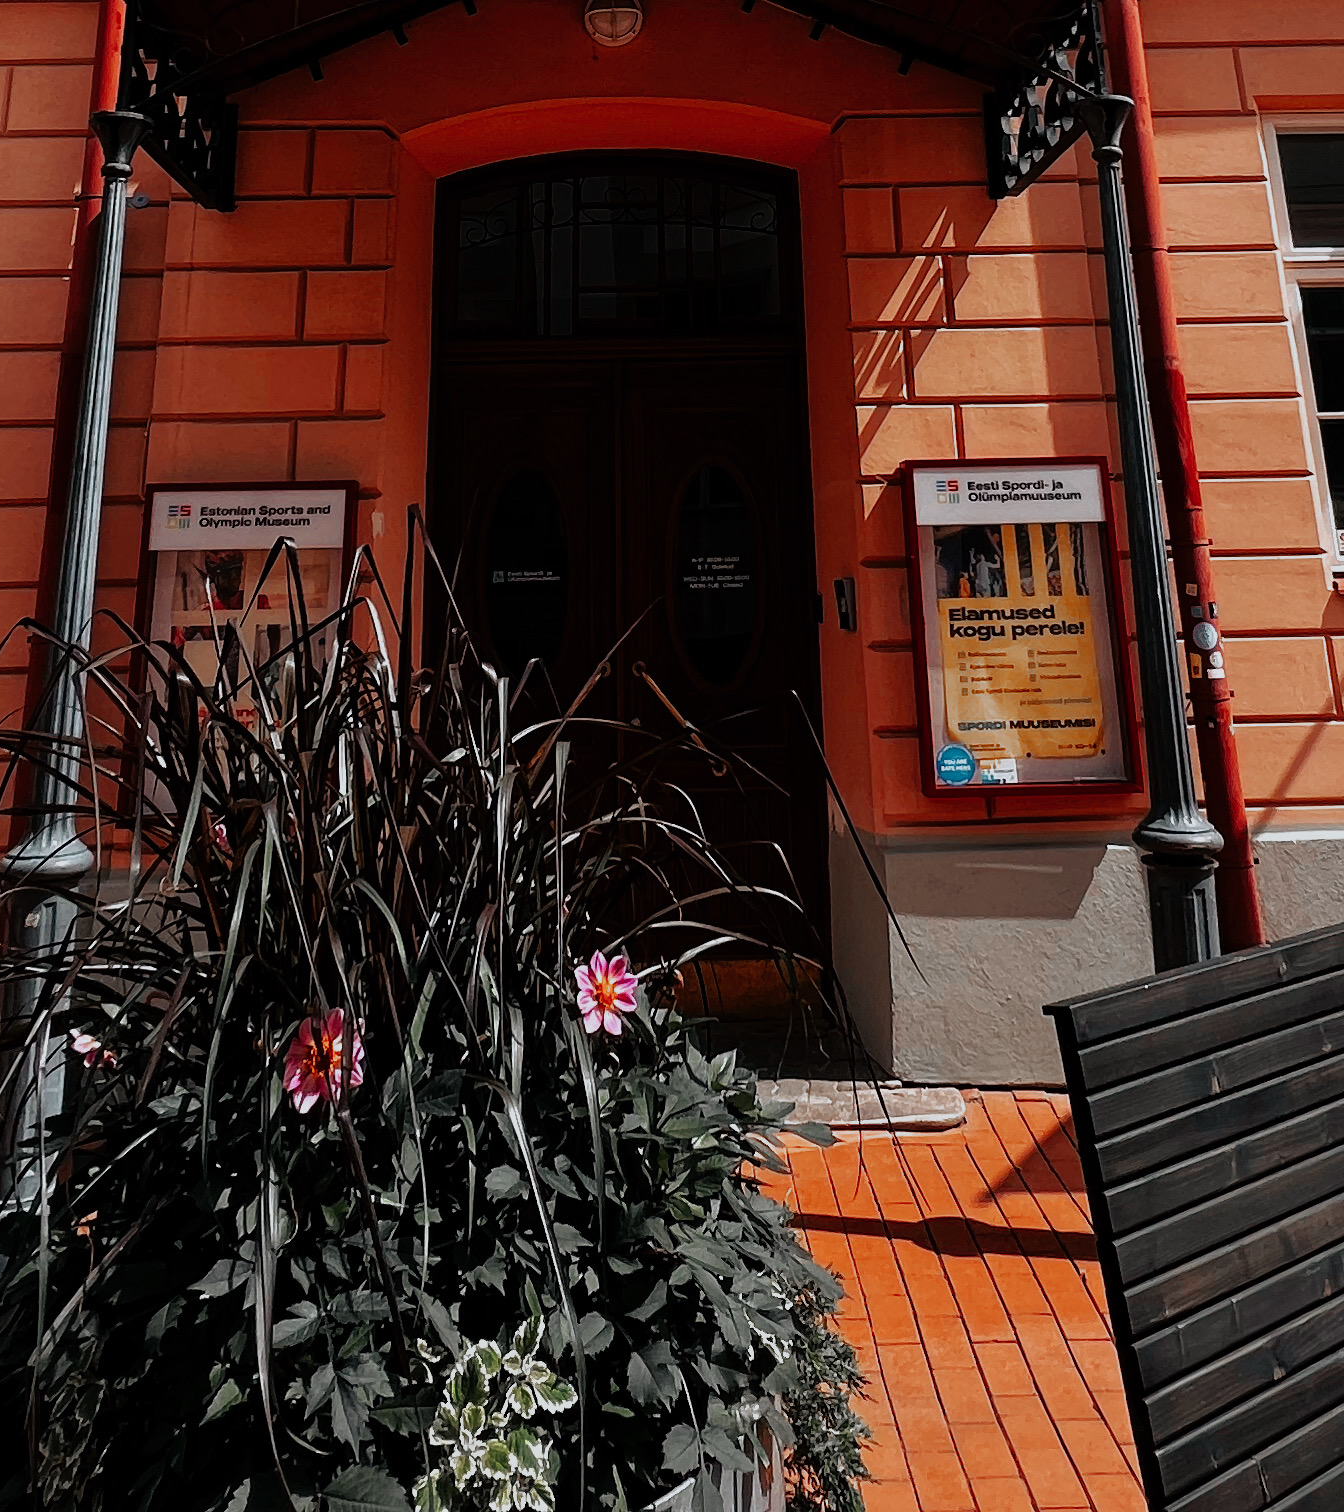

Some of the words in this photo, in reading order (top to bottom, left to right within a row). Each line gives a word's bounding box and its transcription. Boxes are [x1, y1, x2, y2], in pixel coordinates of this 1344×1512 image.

[967, 481, 999, 491] Eesti
[1002, 480, 1050, 492] Spordi-
[1052, 480, 1064, 491] ja
[968, 491, 1082, 503] Olümpiamuuseum
[200, 506, 256, 516] Estonian
[258, 505, 304, 517] Sports
[306, 504, 331, 514] and
[199, 517, 252, 529] Olympic
[255, 517, 310, 527] Museum
[948, 604, 1056, 621] Elamused
[949, 622, 1006, 641] kogu
[1011, 620, 1085, 640] perele!
[957, 721, 1006, 731] SPORDI
